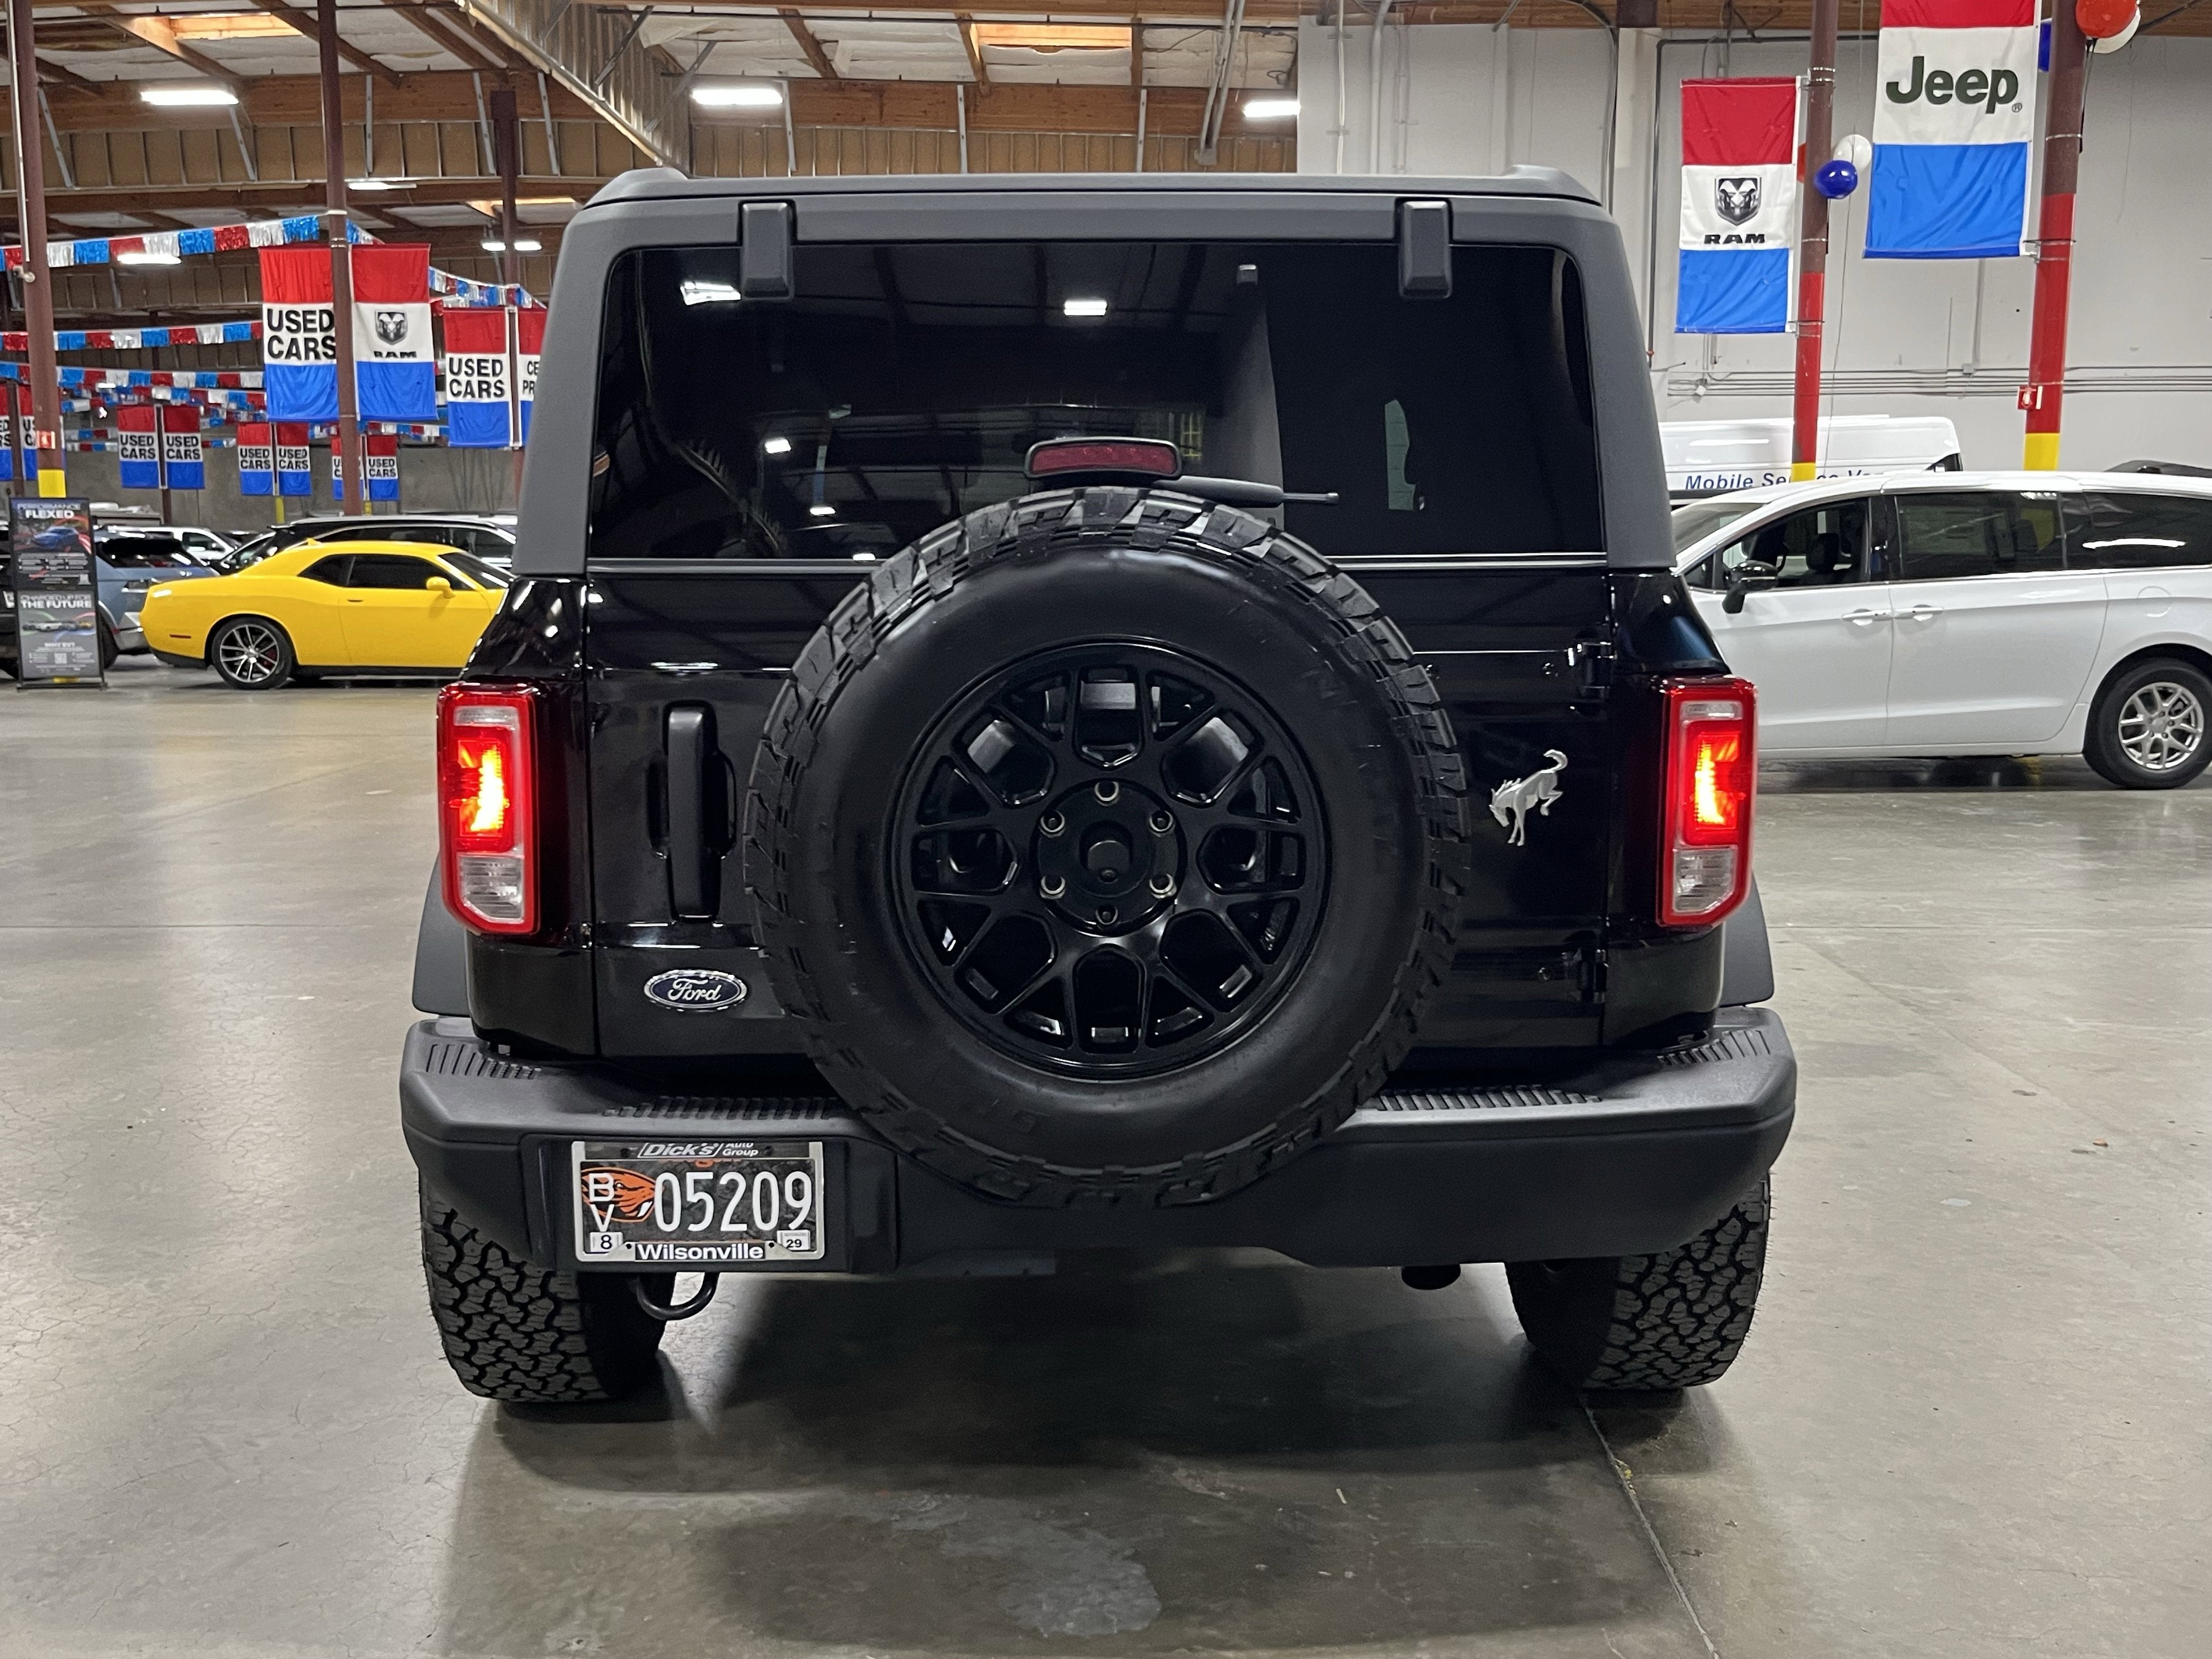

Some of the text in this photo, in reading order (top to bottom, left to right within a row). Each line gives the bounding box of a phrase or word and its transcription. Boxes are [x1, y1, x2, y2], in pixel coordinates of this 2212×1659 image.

[1886, 55, 2019, 115] Jeep
[1703, 234, 1765, 245] RAM
[267, 308, 335, 334] USED
[267, 335, 336, 360] CARS
[374, 351, 417, 359] RAM
[449, 357, 504, 377] USED
[449, 379, 505, 399] CARS
[120, 434, 154, 447] USED
[166, 435, 199, 447] USED
[121, 447, 156, 460] CARS
[166, 448, 201, 460] CARS
[240, 448, 270, 459] USED
[279, 448, 307, 459] USED
[241, 459, 271, 470] CARS
[279, 459, 309, 470] CARS
[368, 458, 395, 467] USED
[369, 468, 396, 477] CARS
[1685, 473, 1753, 489] Mobile
[25, 509, 75, 519] FLEXED
[21, 600, 92, 608] THE FUTURE
[667, 978, 722, 1001] Ford
[644, 1143, 715, 1156] Dick's
[723, 1148, 758, 1157] Group
[654, 1171, 812, 1232] 05209
[601, 1234, 612, 1250] 8
[786, 1239, 803, 1248] 29
[637, 1243, 764, 1260] Wilsonville
